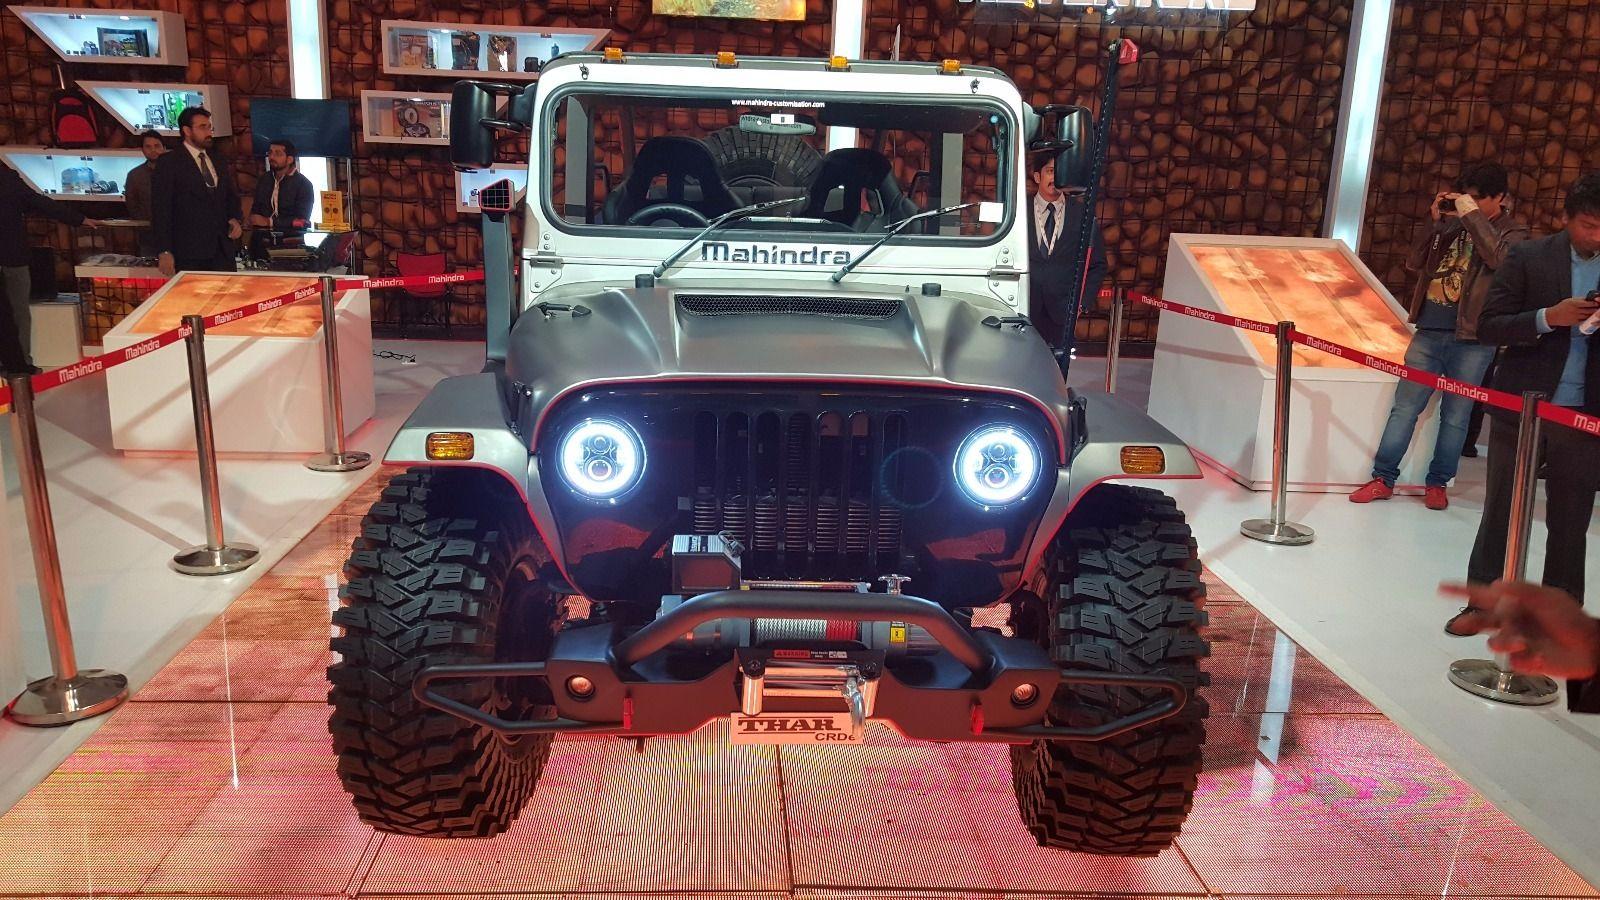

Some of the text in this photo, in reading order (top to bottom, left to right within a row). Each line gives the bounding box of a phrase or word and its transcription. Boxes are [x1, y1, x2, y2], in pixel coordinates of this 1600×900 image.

[701, 241, 851, 265] Mahindra
[363, 274, 465, 288] Mahindra Mahindra
[1141, 295, 1270, 333] Mahindra Mahindra Mahindra
[59, 286, 315, 384] Mahindra Mahindra Mah Mahindra Mahindra Mahindra
[1306, 336, 1342, 356] Mahindra
[1365, 355, 1408, 378] Mahindra
[1437, 377, 1489, 402] Mahindra
[738, 719, 842, 732] THAR
